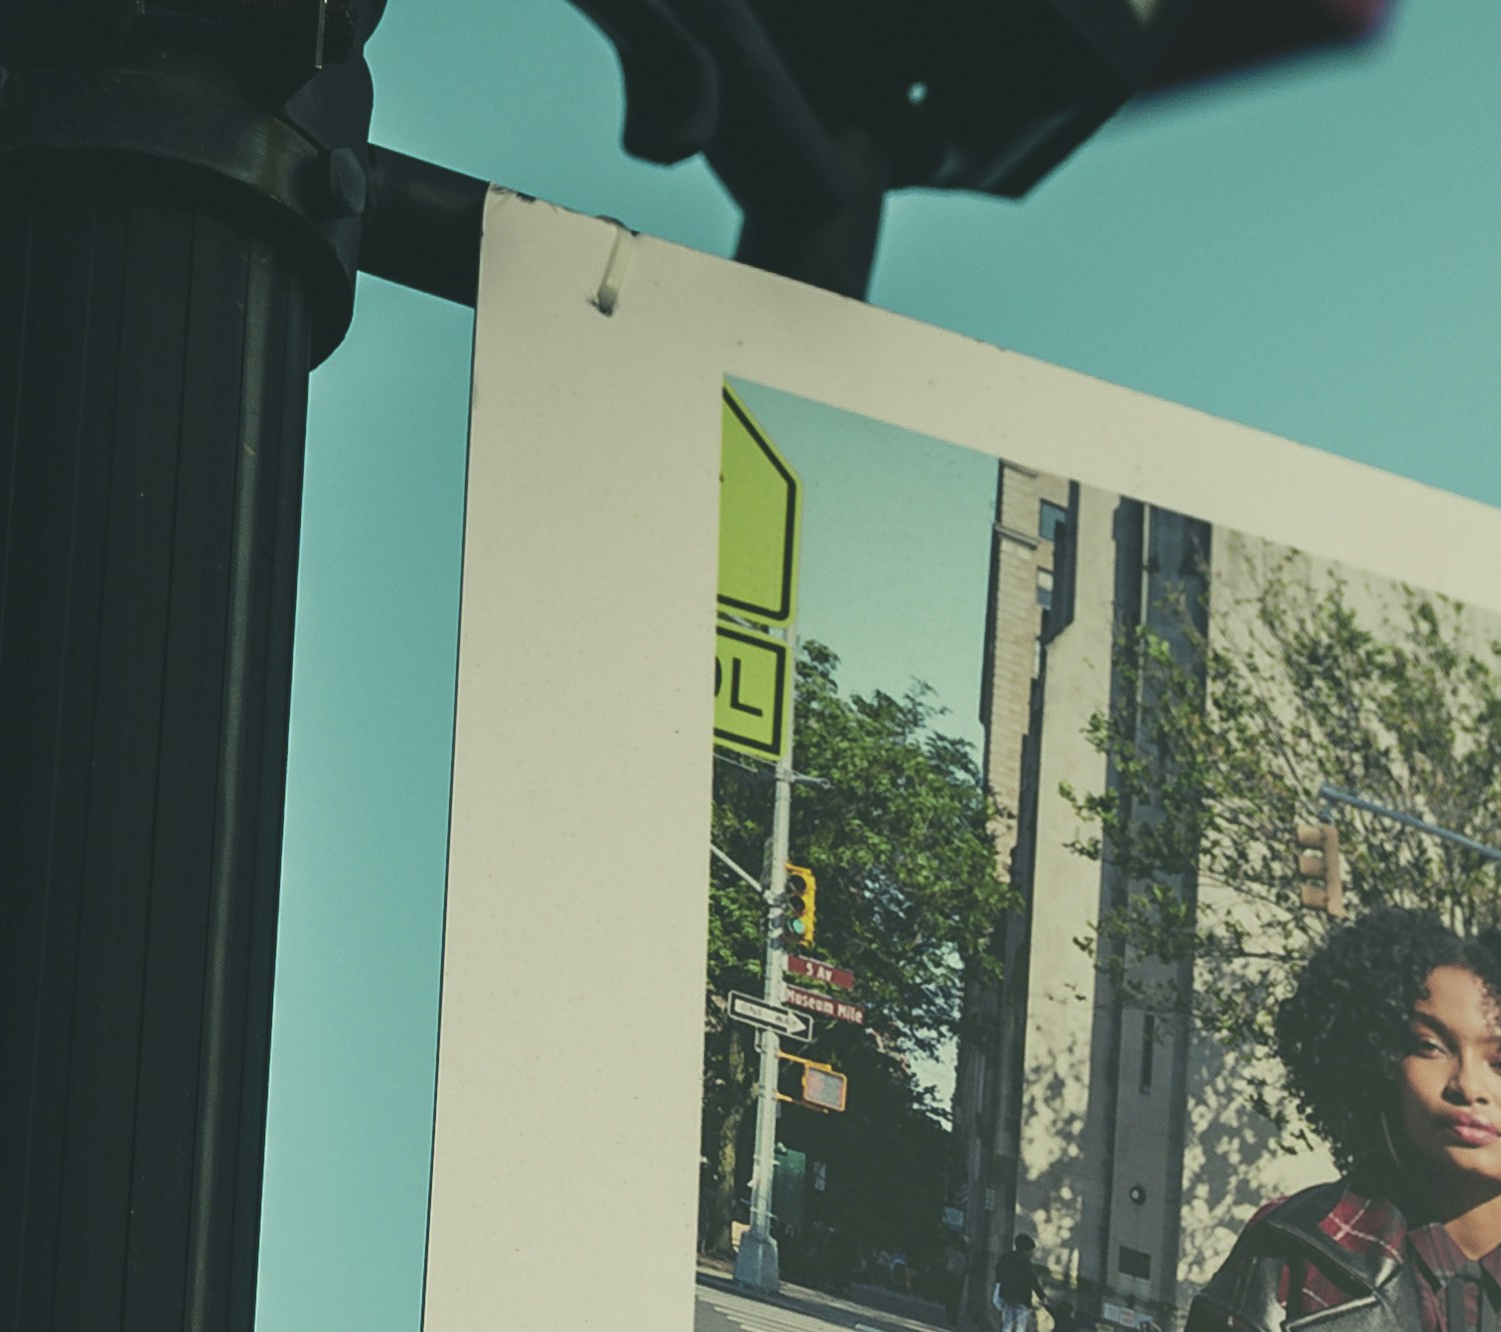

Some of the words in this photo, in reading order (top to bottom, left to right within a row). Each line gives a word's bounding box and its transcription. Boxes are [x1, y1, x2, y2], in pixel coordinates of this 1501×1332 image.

[714, 655, 763, 718] L
[805, 962, 814, 976] 5
[786, 989, 834, 1015] Museum
[837, 1004, 863, 1024] Mile
